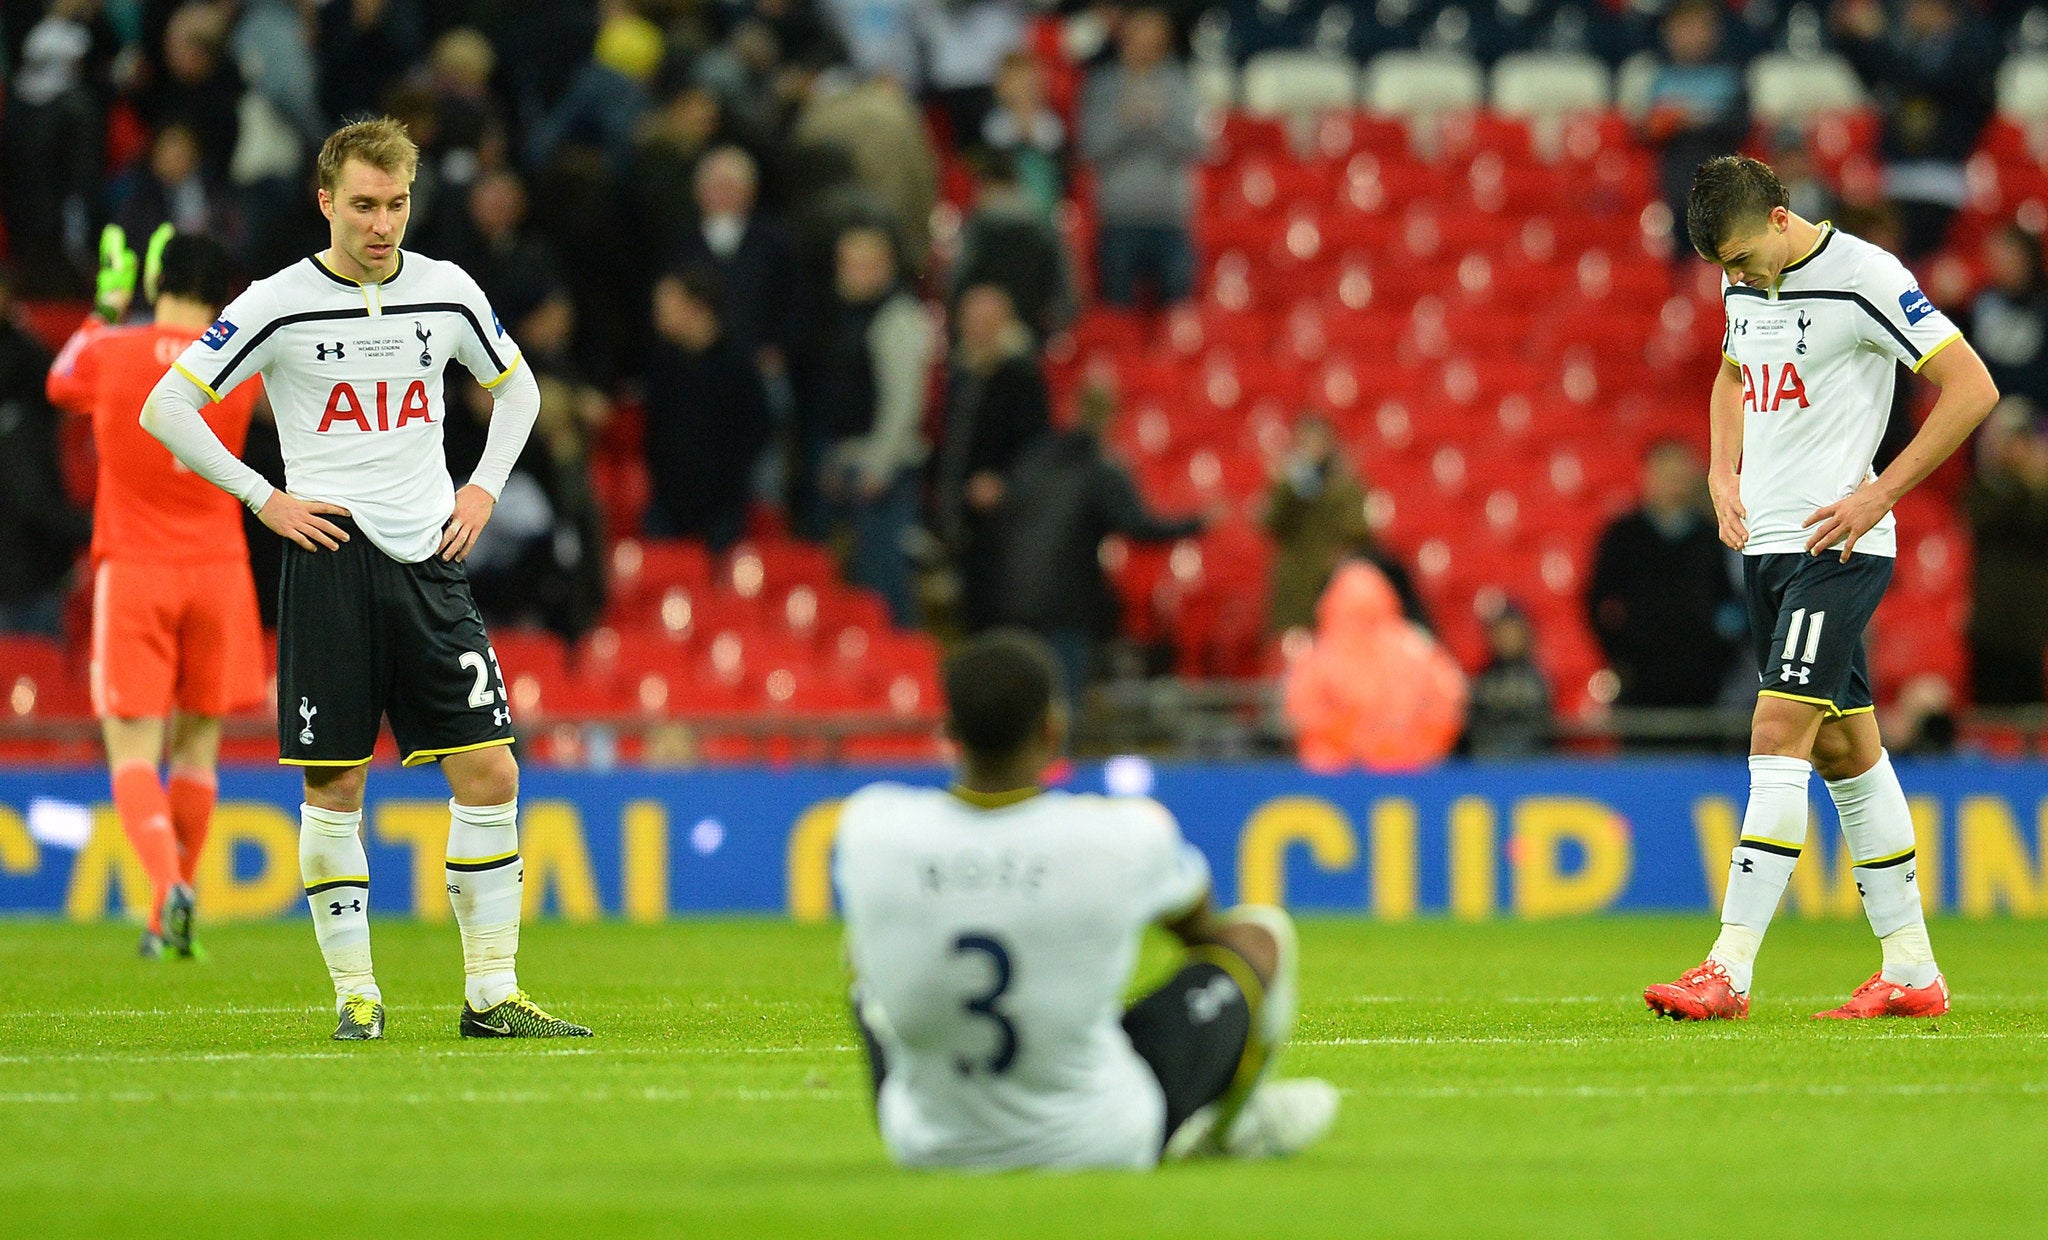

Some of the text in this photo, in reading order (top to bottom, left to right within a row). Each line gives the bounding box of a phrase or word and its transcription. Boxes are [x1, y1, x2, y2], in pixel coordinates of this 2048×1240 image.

[317, 379, 436, 433] AIA
[1743, 363, 1811, 413] AIA
[1780, 607, 1825, 664] 11
[458, 646, 508, 708] 23
[950, 931, 1020, 1078] 3
